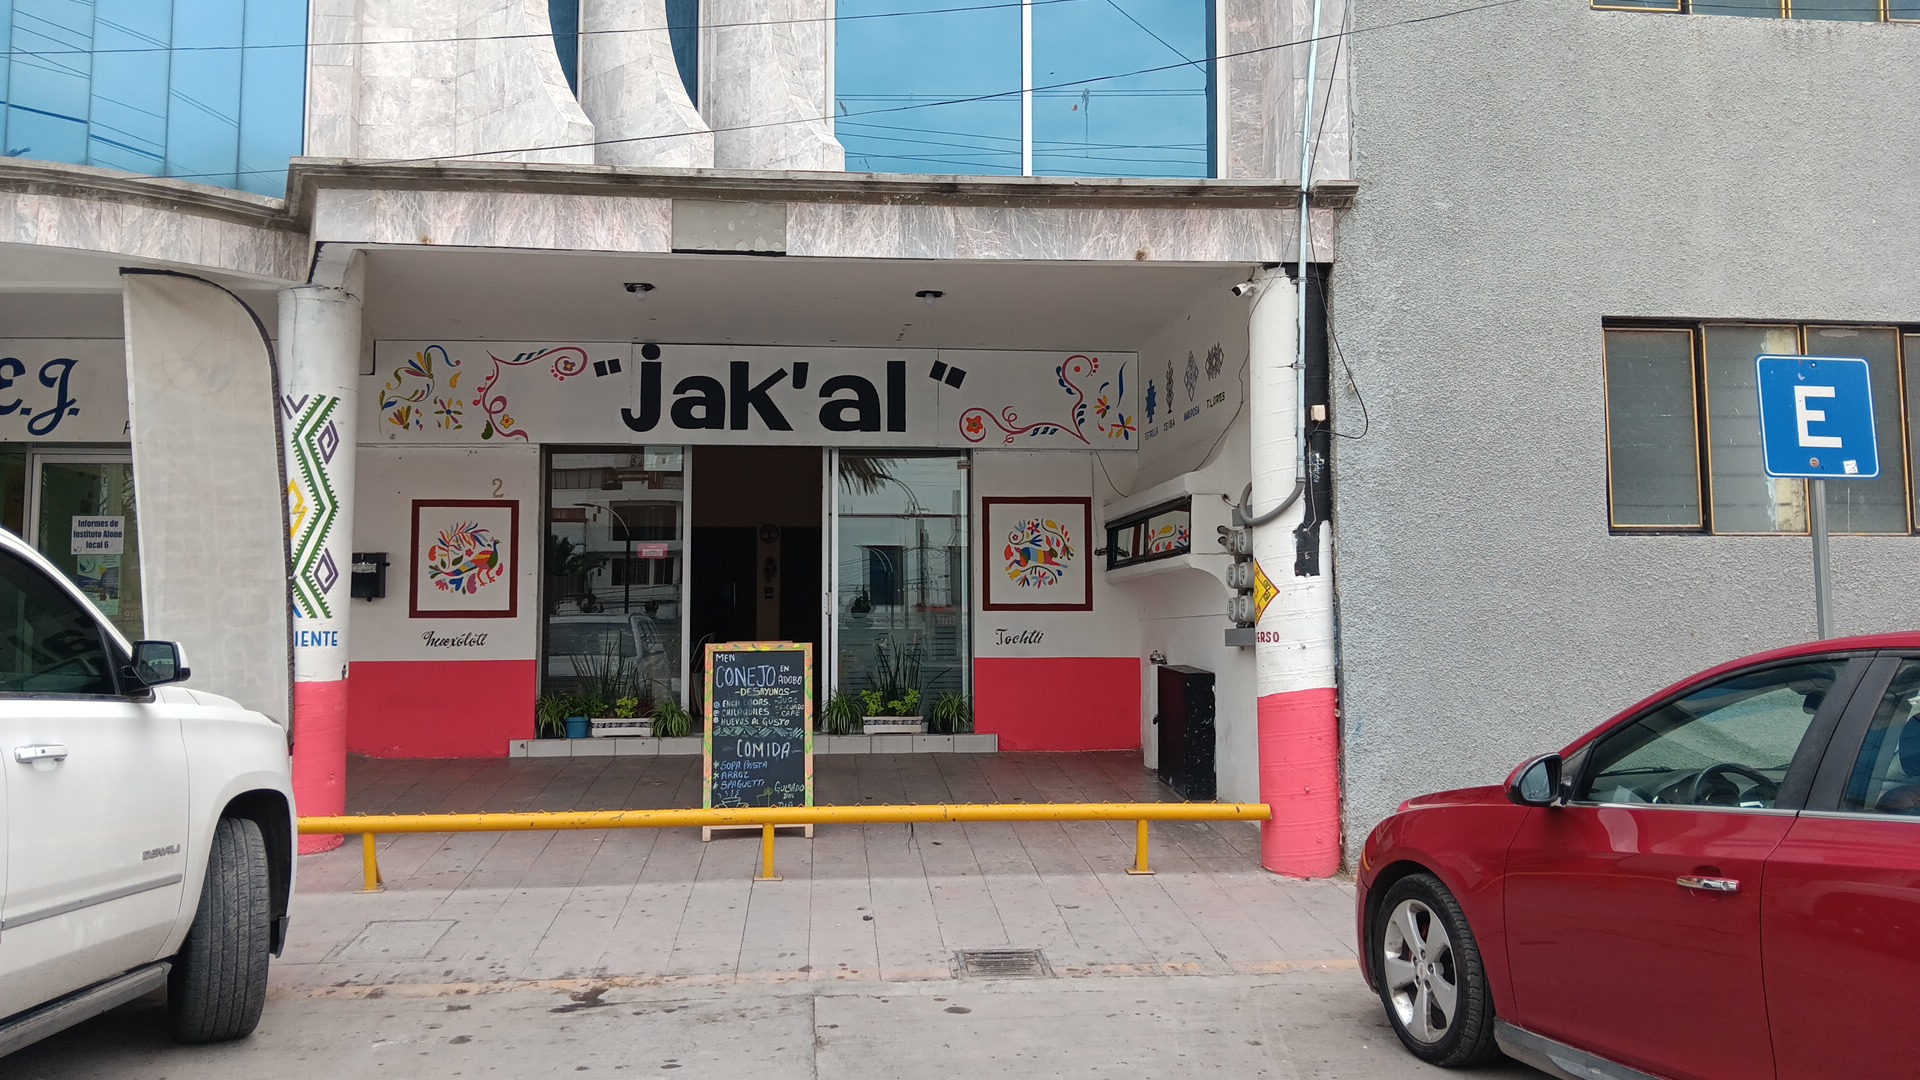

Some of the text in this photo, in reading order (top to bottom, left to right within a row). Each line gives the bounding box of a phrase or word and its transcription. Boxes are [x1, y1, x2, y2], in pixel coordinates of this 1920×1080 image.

[1794, 385, 1842, 448] E
[492, 478, 504, 498] 2
[78, 519, 118, 528] Informes de
[73, 530, 123, 538] Instituto Alone
[86, 540, 109, 549] local 6
[716, 665, 776, 688] CONEJO
[778, 675, 803, 685] ADOBO
[720, 717, 790, 727] HUEVOS AL GUSTO
[737, 738, 791, 759] COMIDA
[720, 760, 768, 770] SOPA PASTA
[721, 771, 750, 780] ARROZ
[720, 779, 765, 790] SPAGUETTI
